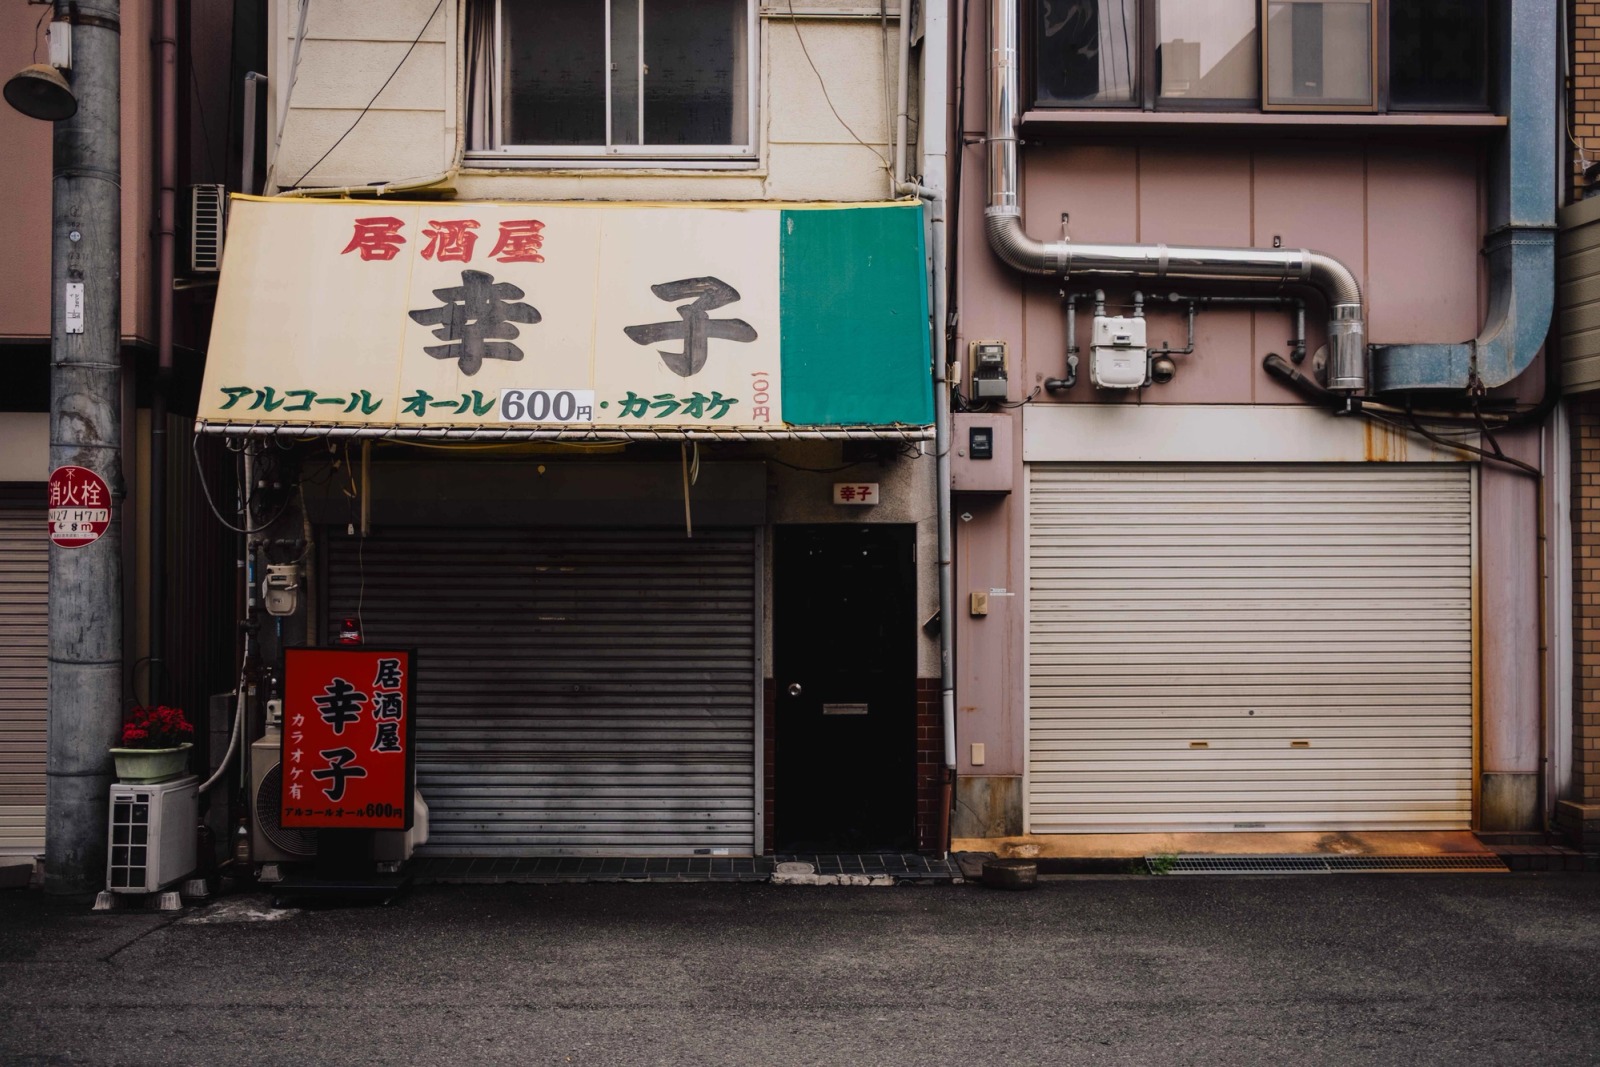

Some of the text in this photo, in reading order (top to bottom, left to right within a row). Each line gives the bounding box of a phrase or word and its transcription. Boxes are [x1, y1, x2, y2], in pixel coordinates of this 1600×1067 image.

[341, 216, 546, 264] 居酒屋
[50, 480, 101, 506] 消火栓
[840, 486, 872, 501] 幸子
[371, 658, 403, 753] 居酒屋
[289, 713, 305, 800] カラオケ有
[311, 677, 368, 802] 幸子
